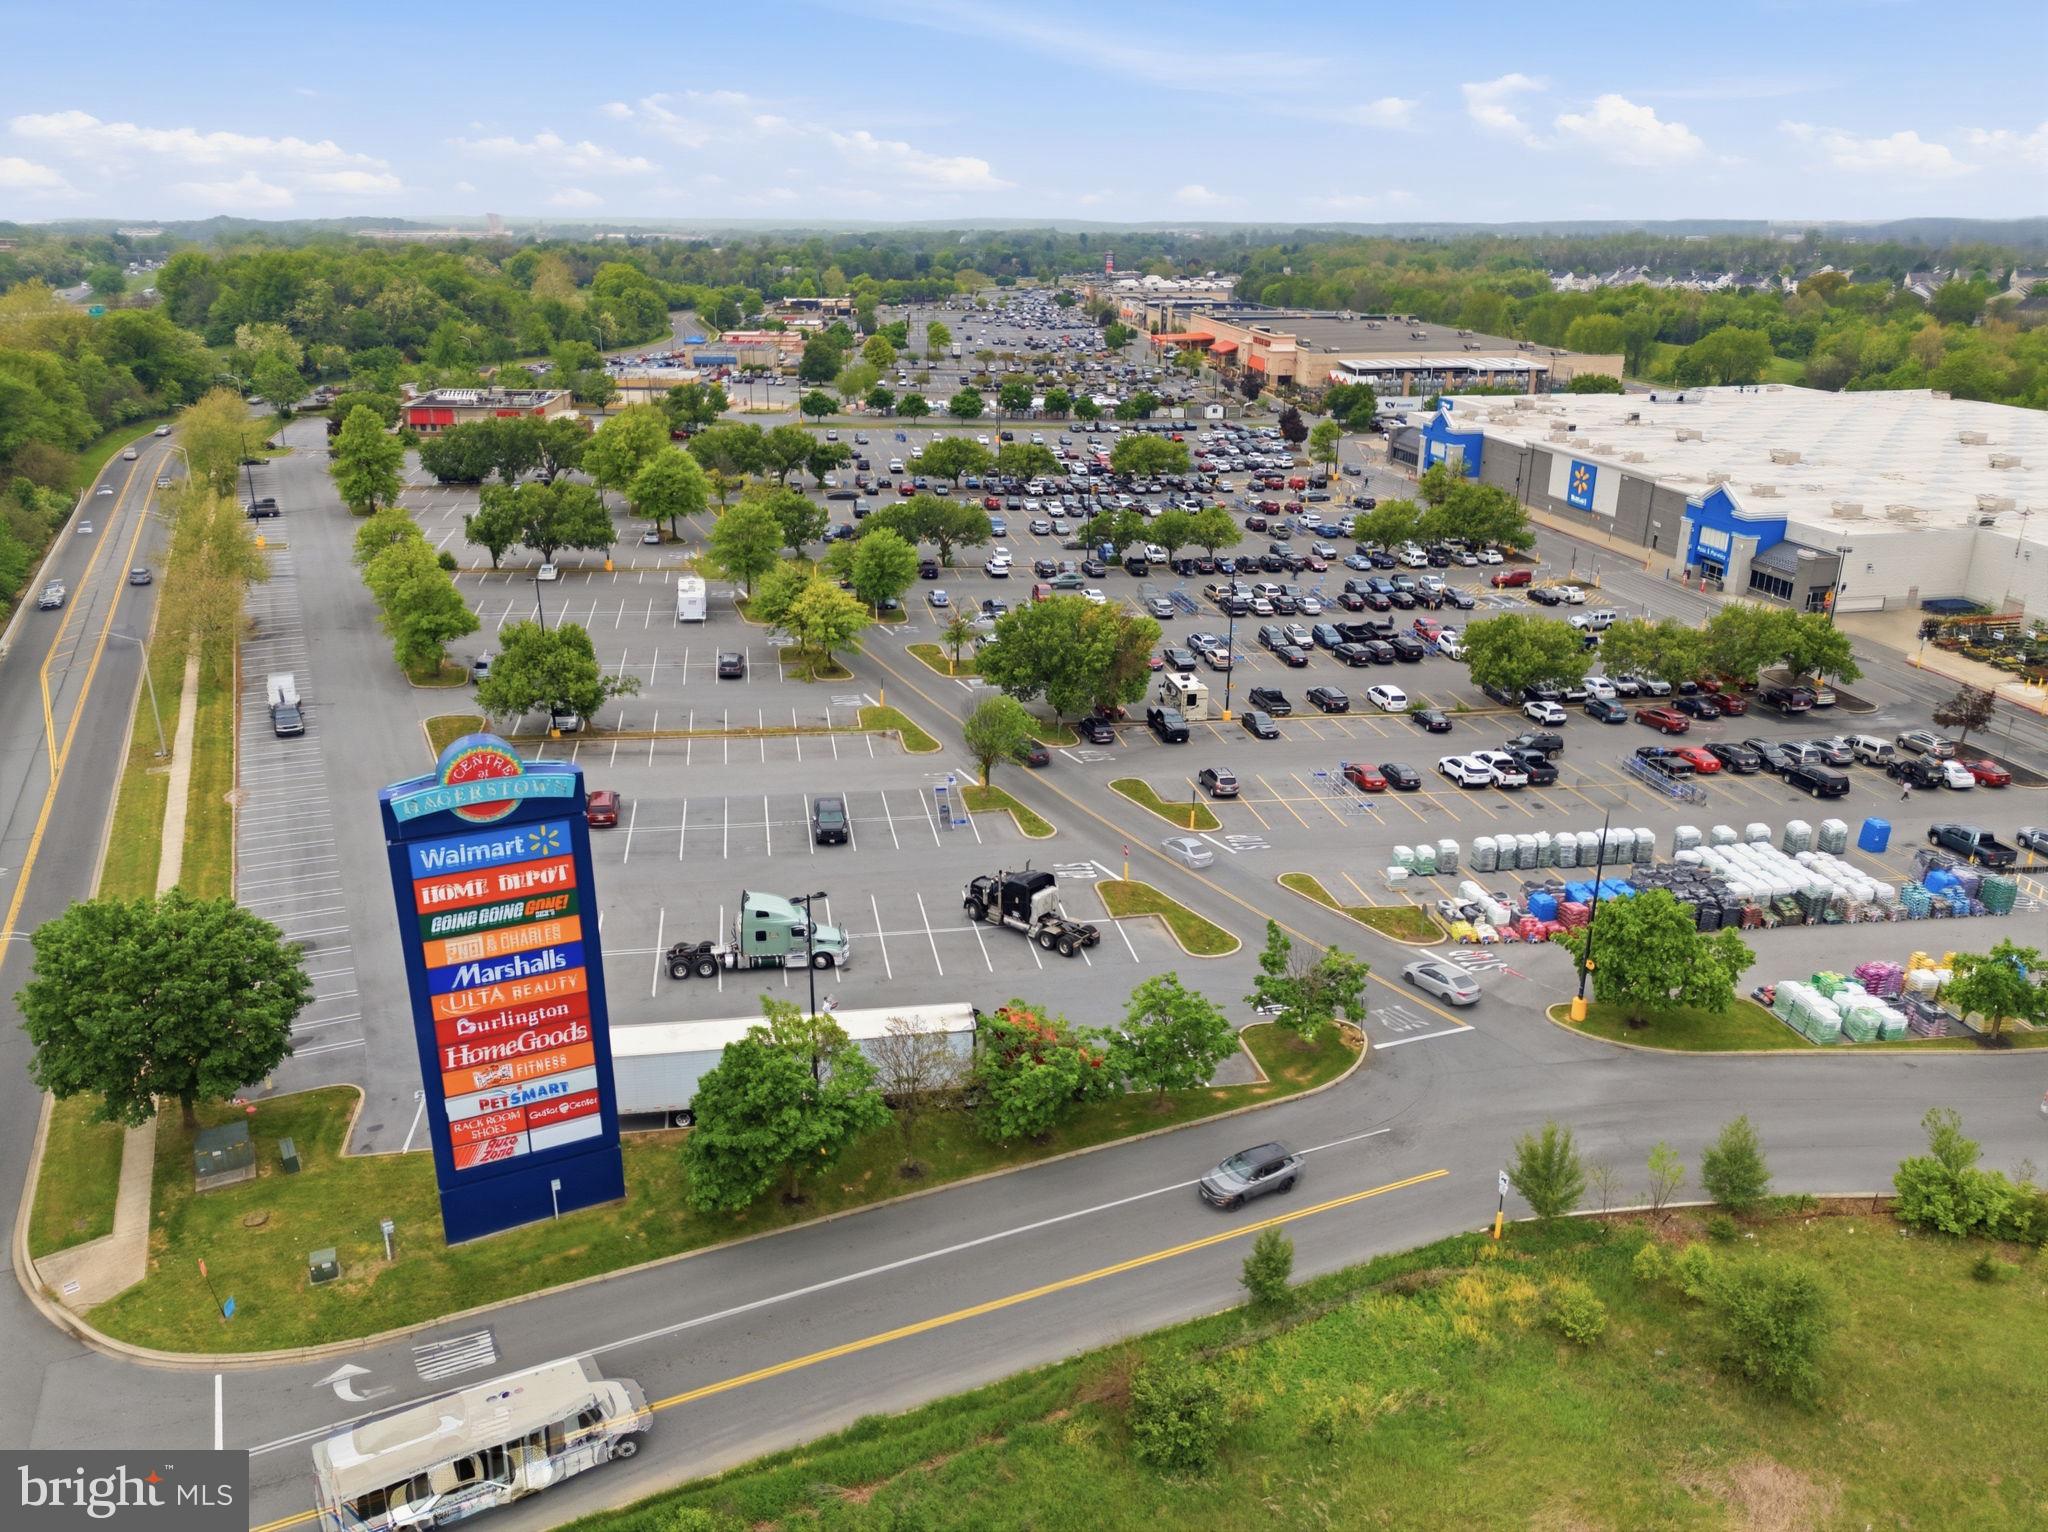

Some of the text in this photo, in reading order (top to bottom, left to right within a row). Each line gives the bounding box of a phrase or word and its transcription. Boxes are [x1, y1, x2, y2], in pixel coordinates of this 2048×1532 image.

[453, 754, 515, 782] CENTRE
[403, 778, 568, 815] HAGERSTOWN
[420, 836, 525, 870] Walmart
[421, 864, 569, 904] HOME DEPOT
[431, 894, 569, 933] GOING GOING GONE!
[500, 923, 561, 950] CHARLES
[451, 949, 567, 989] Marshalls
[450, 973, 578, 1011] ULTA BEAUTY
[457, 1004, 569, 1036] Burlington
[445, 1021, 588, 1069] HomeGoods
[517, 1053, 567, 1076] FITNESS
[479, 1081, 569, 1111] PETSMART
[529, 1097, 598, 1120] Guitar Center
[454, 1110, 521, 1133] RACK ROOM
[471, 1126, 507, 1139] SHOES
